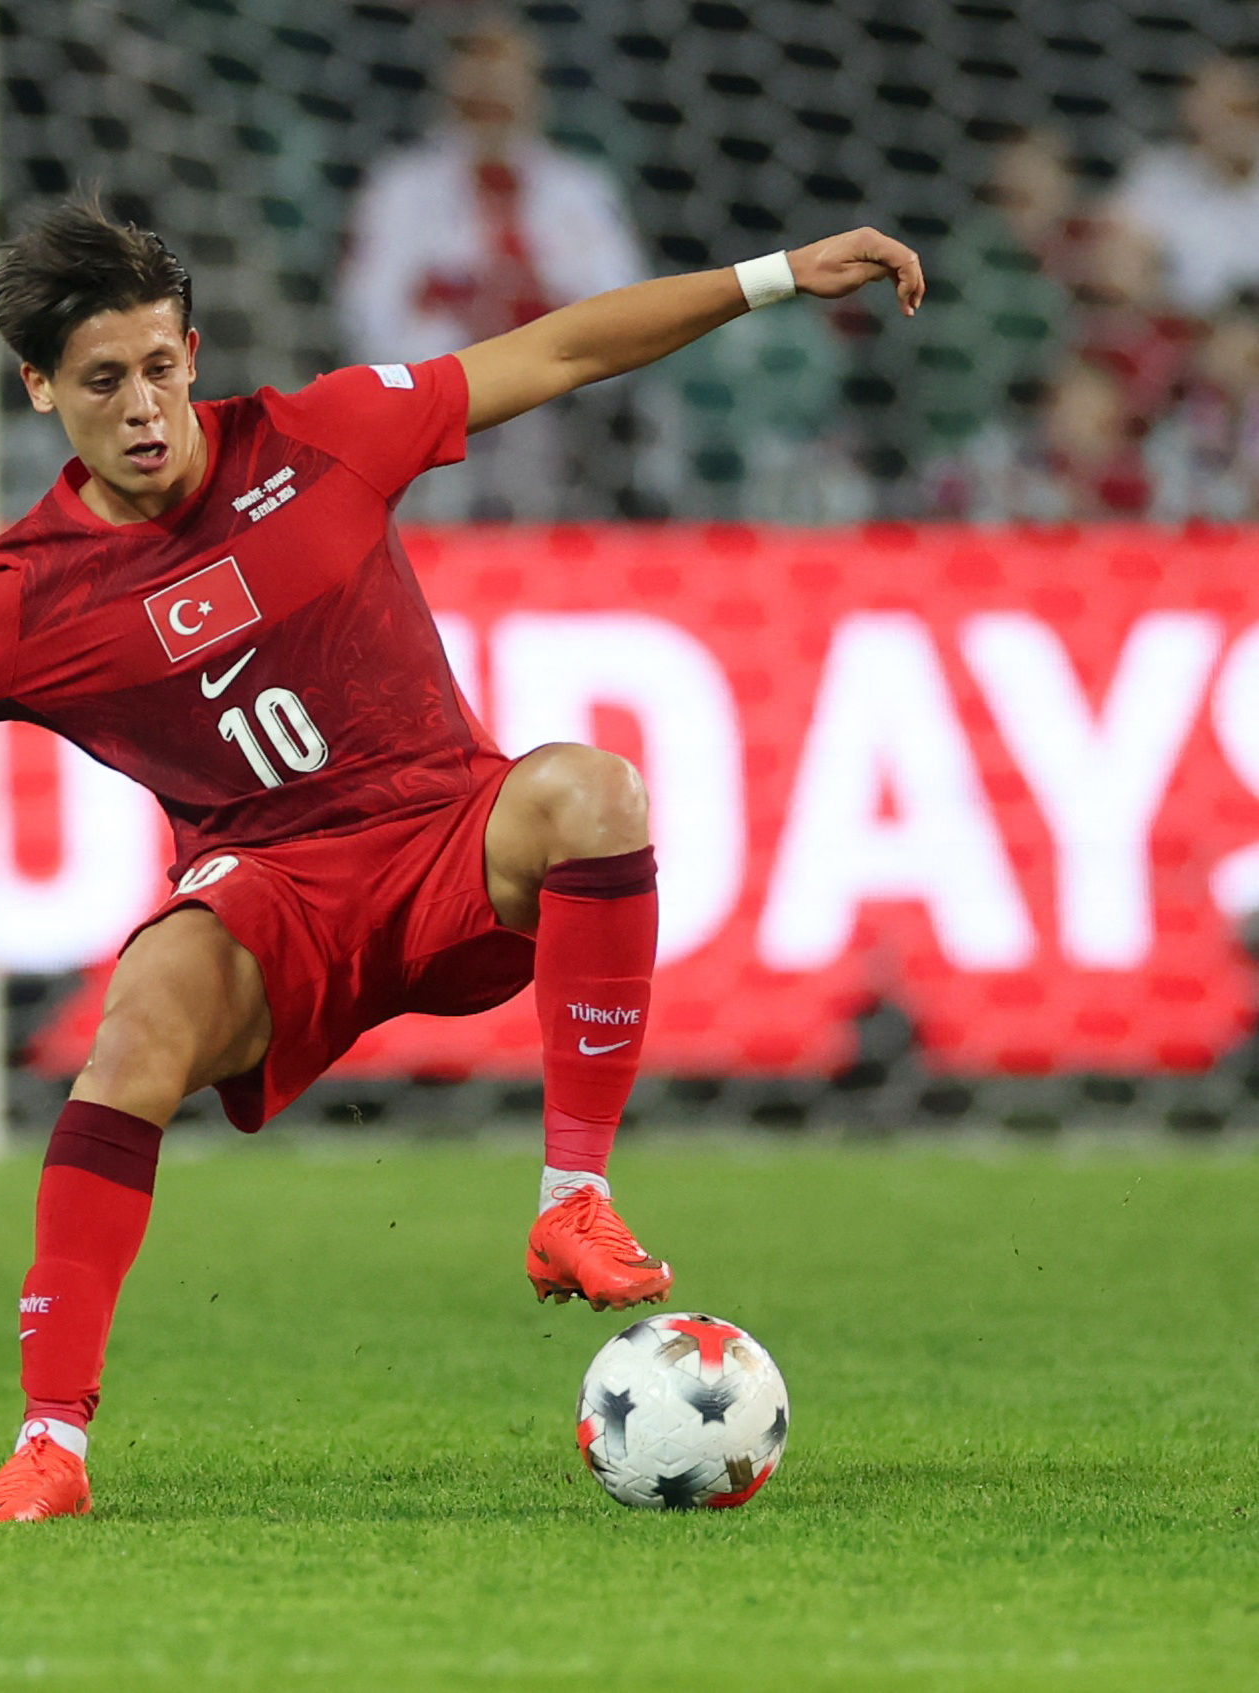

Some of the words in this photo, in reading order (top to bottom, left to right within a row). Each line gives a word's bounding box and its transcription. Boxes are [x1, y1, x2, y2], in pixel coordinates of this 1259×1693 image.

[263, 465, 296, 492] FRANSA
[218, 687, 329, 789] 10
[566, 1002, 641, 1025] TÜRKİYE
